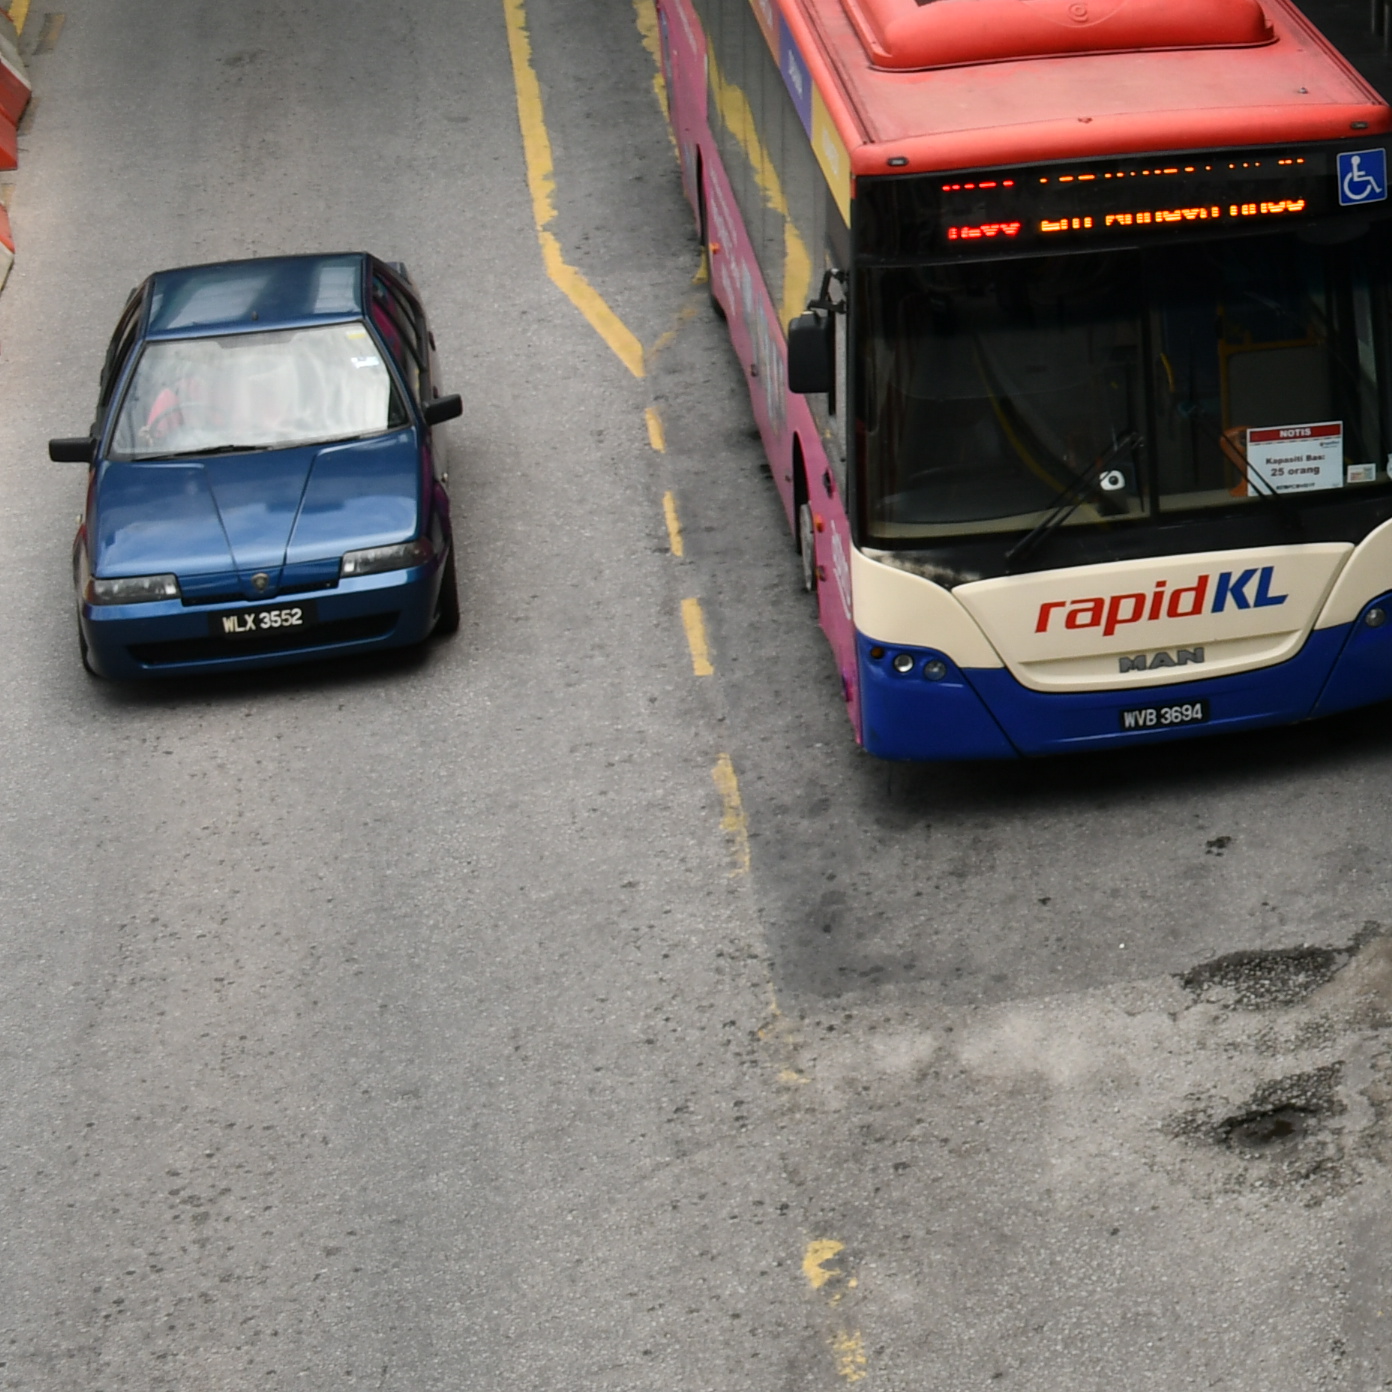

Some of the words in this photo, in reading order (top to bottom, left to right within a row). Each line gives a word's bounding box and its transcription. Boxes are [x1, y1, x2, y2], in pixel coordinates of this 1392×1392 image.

[1279, 428, 1311, 437] NOTIS
[1266, 456, 1303, 465] Kapasiti
[1271, 468, 1284, 476] 25
[1288, 466, 1320, 475] orang
[1034, 565, 1289, 637] rapidKL
[222, 615, 256, 633] WLX
[259, 608, 303, 630] 3552
[1119, 647, 1205, 674] MAN
[1123, 709, 1157, 729] WVB
[1160, 703, 1203, 725] 3694
